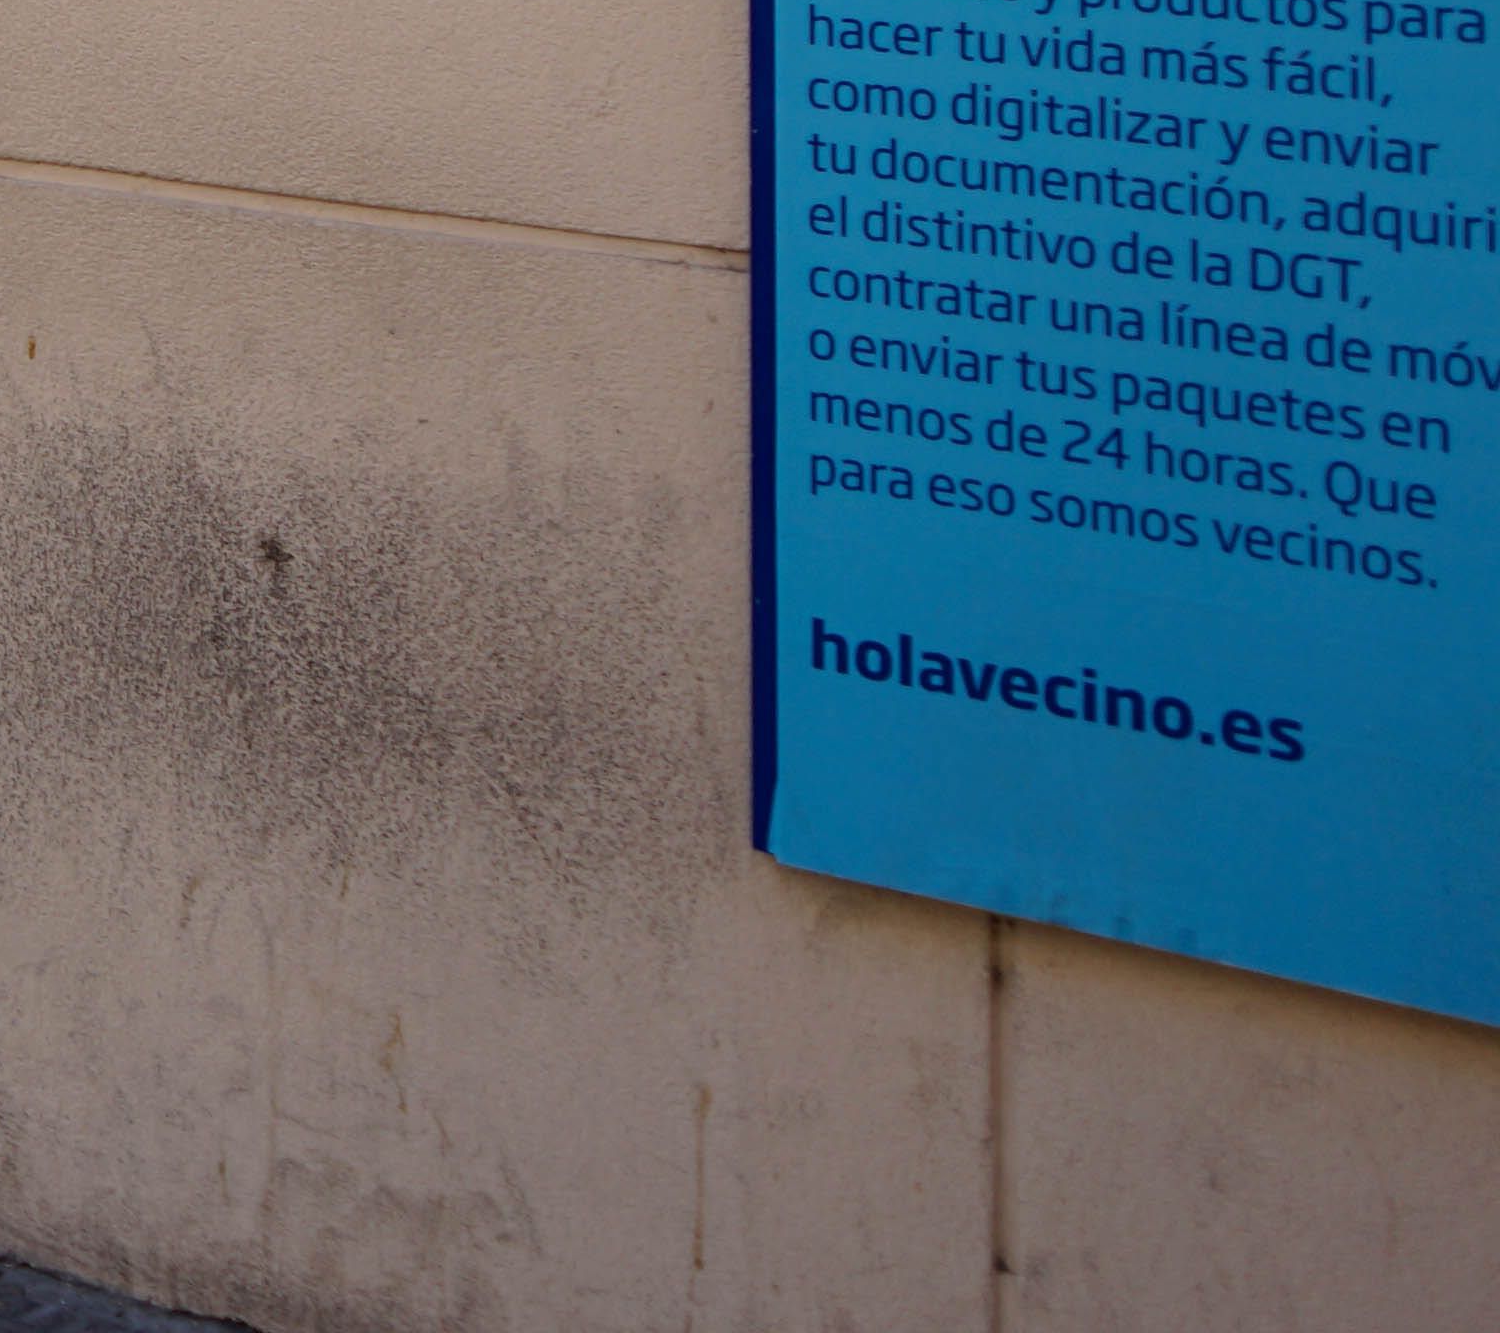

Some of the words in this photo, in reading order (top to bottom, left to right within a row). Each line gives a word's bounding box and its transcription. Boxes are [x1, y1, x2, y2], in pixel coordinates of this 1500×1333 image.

[808, 5, 944, 57] hacer
[958, 21, 1005, 64] tu
[1021, 29, 1126, 77] vida
[1143, 42, 1248, 90] más
[1264, 47, 1393, 108] fácil,
[1365, 0, 1486, 44] para
[808, 77, 936, 121] como
[952, 83, 1206, 151] digitalizar
[1219, 119, 1250, 166] y
[1266, 124, 1438, 176] enviar
[808, 133, 856, 176] tu
[872, 138, 1285, 230] documentación,
[1303, 191, 1499, 254] adquiri
[808, 196, 847, 237] el
[862, 200, 1096, 270] distintivo
[1111, 232, 1174, 279] de
[1191, 240, 1232, 288] la
[1251, 247, 1372, 309] DGT,
[809, 265, 1036, 325] contratar
[1051, 299, 1143, 342] una
[1161, 301, 1288, 363] línea
[1305, 325, 1372, 373] de
[1390, 343, 1500, 392] móv
[809, 330, 836, 361] o
[850, 330, 1002, 386] enviar
[1017, 350, 1097, 401] tus
[1113, 371, 1365, 441] paquetes
[1381, 414, 1451, 454] en
[810, 390, 973, 447] menos
[986, 410, 1048, 458] de
[1063, 421, 1130, 471] 24
[1145, 430, 1307, 499] horas.
[1325, 461, 1437, 520] Que
[810, 452, 913, 500] para
[929, 472, 1016, 516] eso
[1031, 489, 1199, 549] somos
[1212, 517, 1438, 589] vecinos.
[810, 617, 1305, 763] holavecino.es
